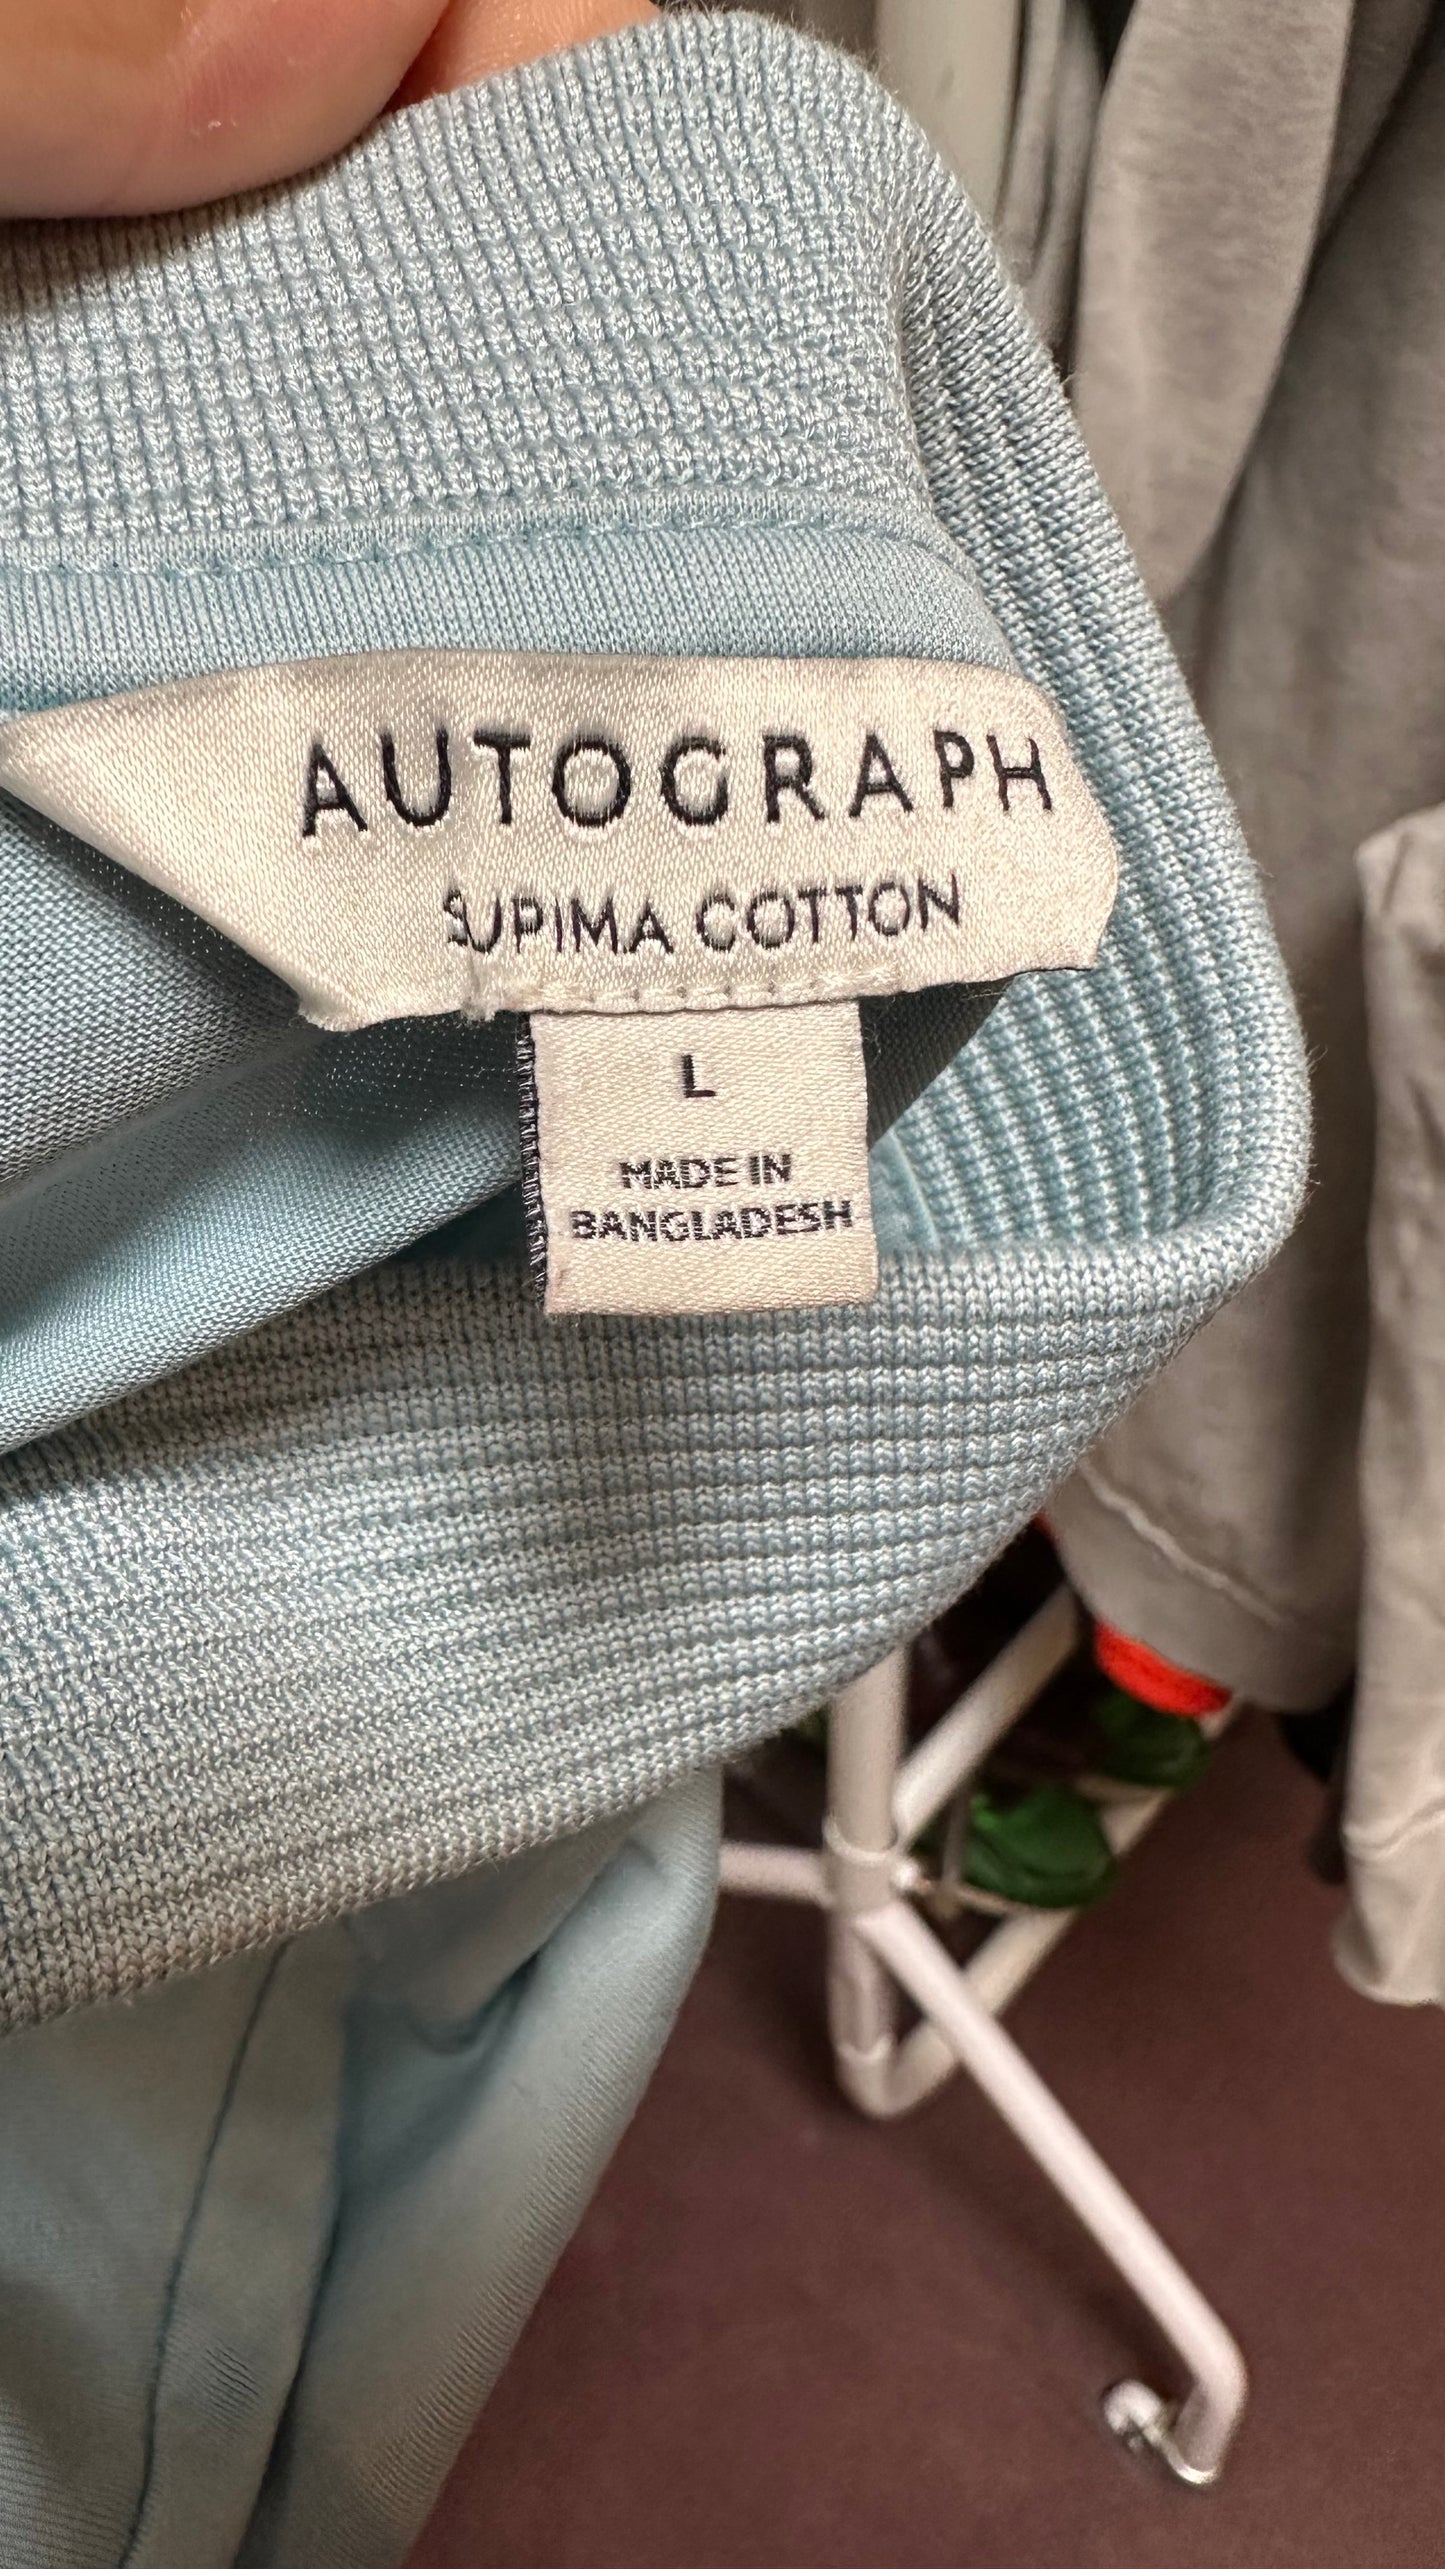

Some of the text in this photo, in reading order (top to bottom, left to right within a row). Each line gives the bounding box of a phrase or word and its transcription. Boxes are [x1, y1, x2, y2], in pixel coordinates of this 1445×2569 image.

[303, 725, 1054, 838] AUTOGRAPH
[443, 875, 961, 955] SUPIMA COTTON
[682, 1054, 716, 1098] L
[619, 1153, 792, 1190] MADE IN
[571, 1200, 853, 1242] BANGLADESH
